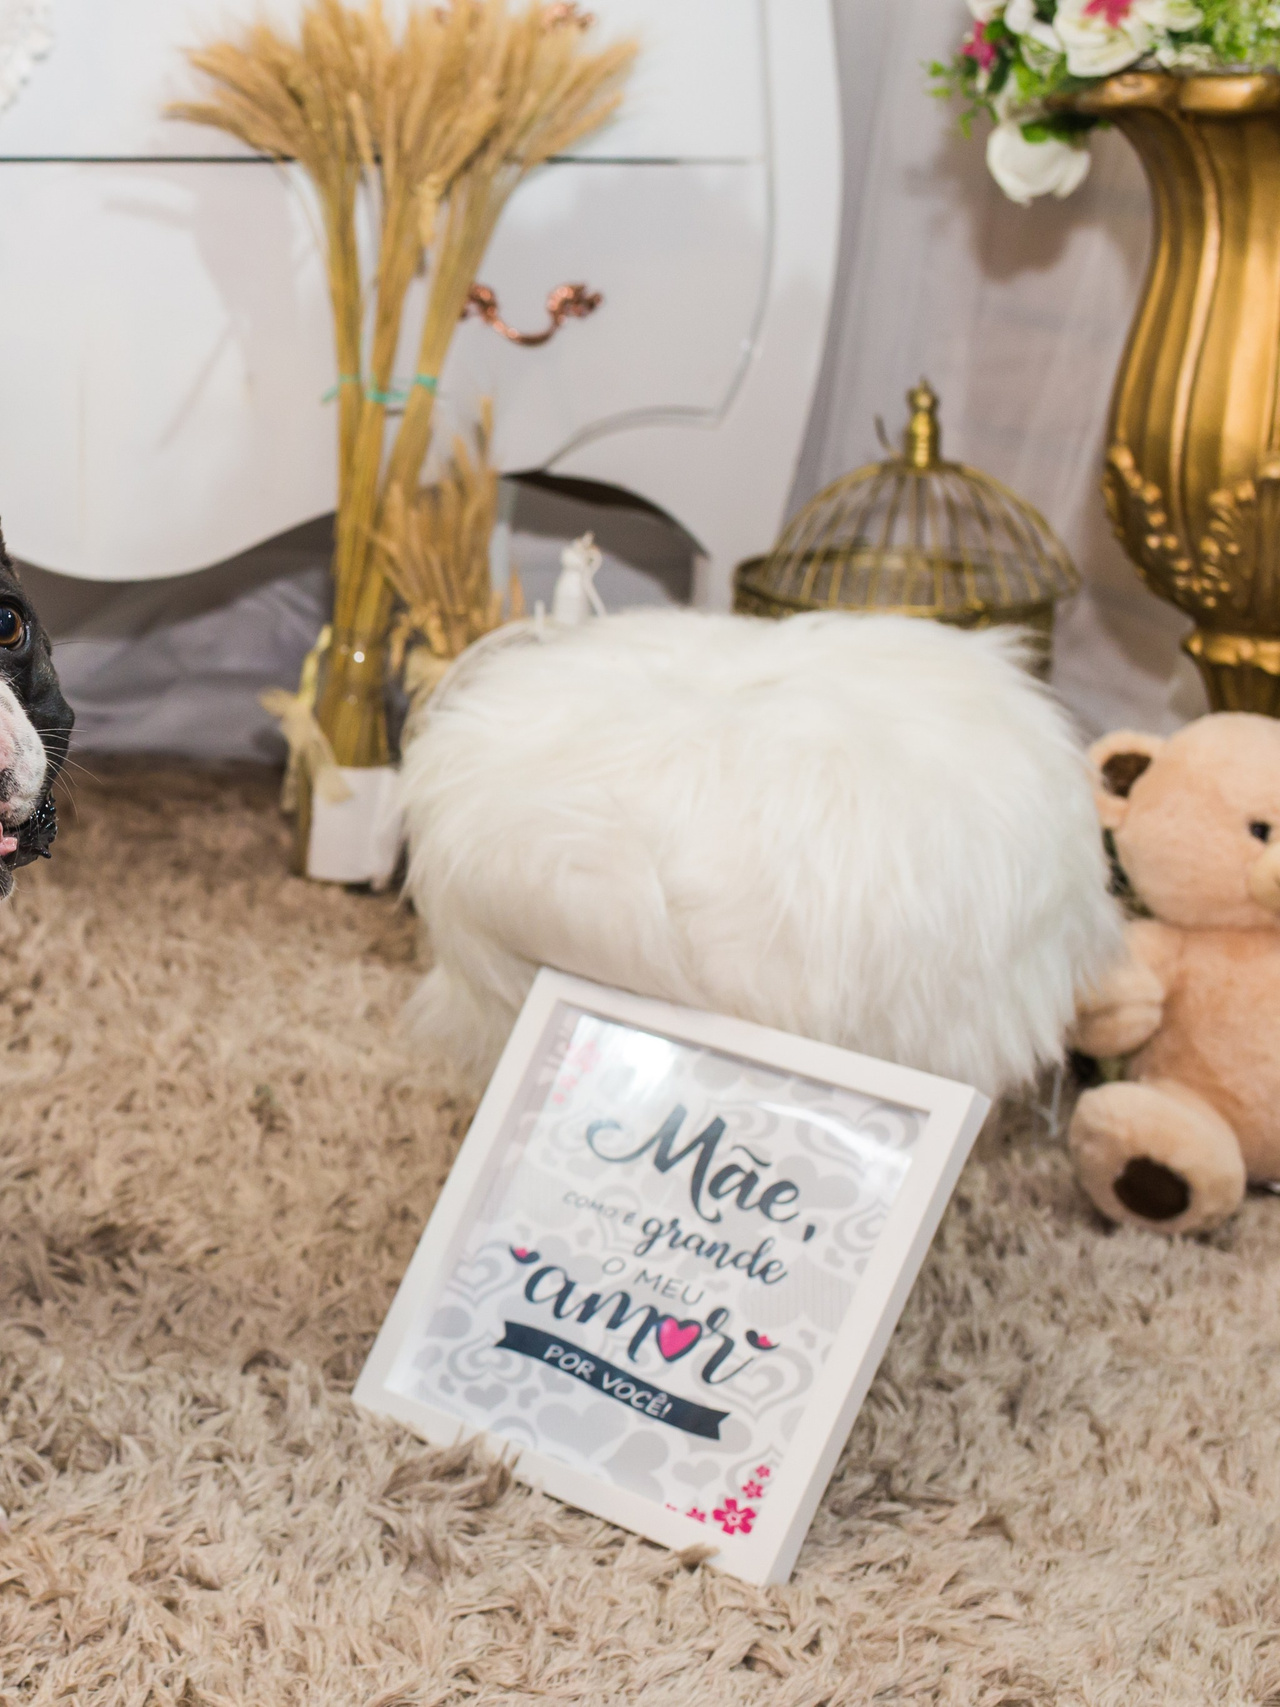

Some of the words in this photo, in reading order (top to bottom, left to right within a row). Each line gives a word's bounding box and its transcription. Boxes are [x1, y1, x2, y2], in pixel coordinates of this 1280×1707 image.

[586, 1103, 816, 1243] Mãe,
[602, 1257, 626, 1276] O
[634, 1268, 704, 1306] MEU
[633, 1217, 788, 1285] grande
[543, 1343, 596, 1381] POR
[600, 1370, 673, 1419] VOCÊ!
